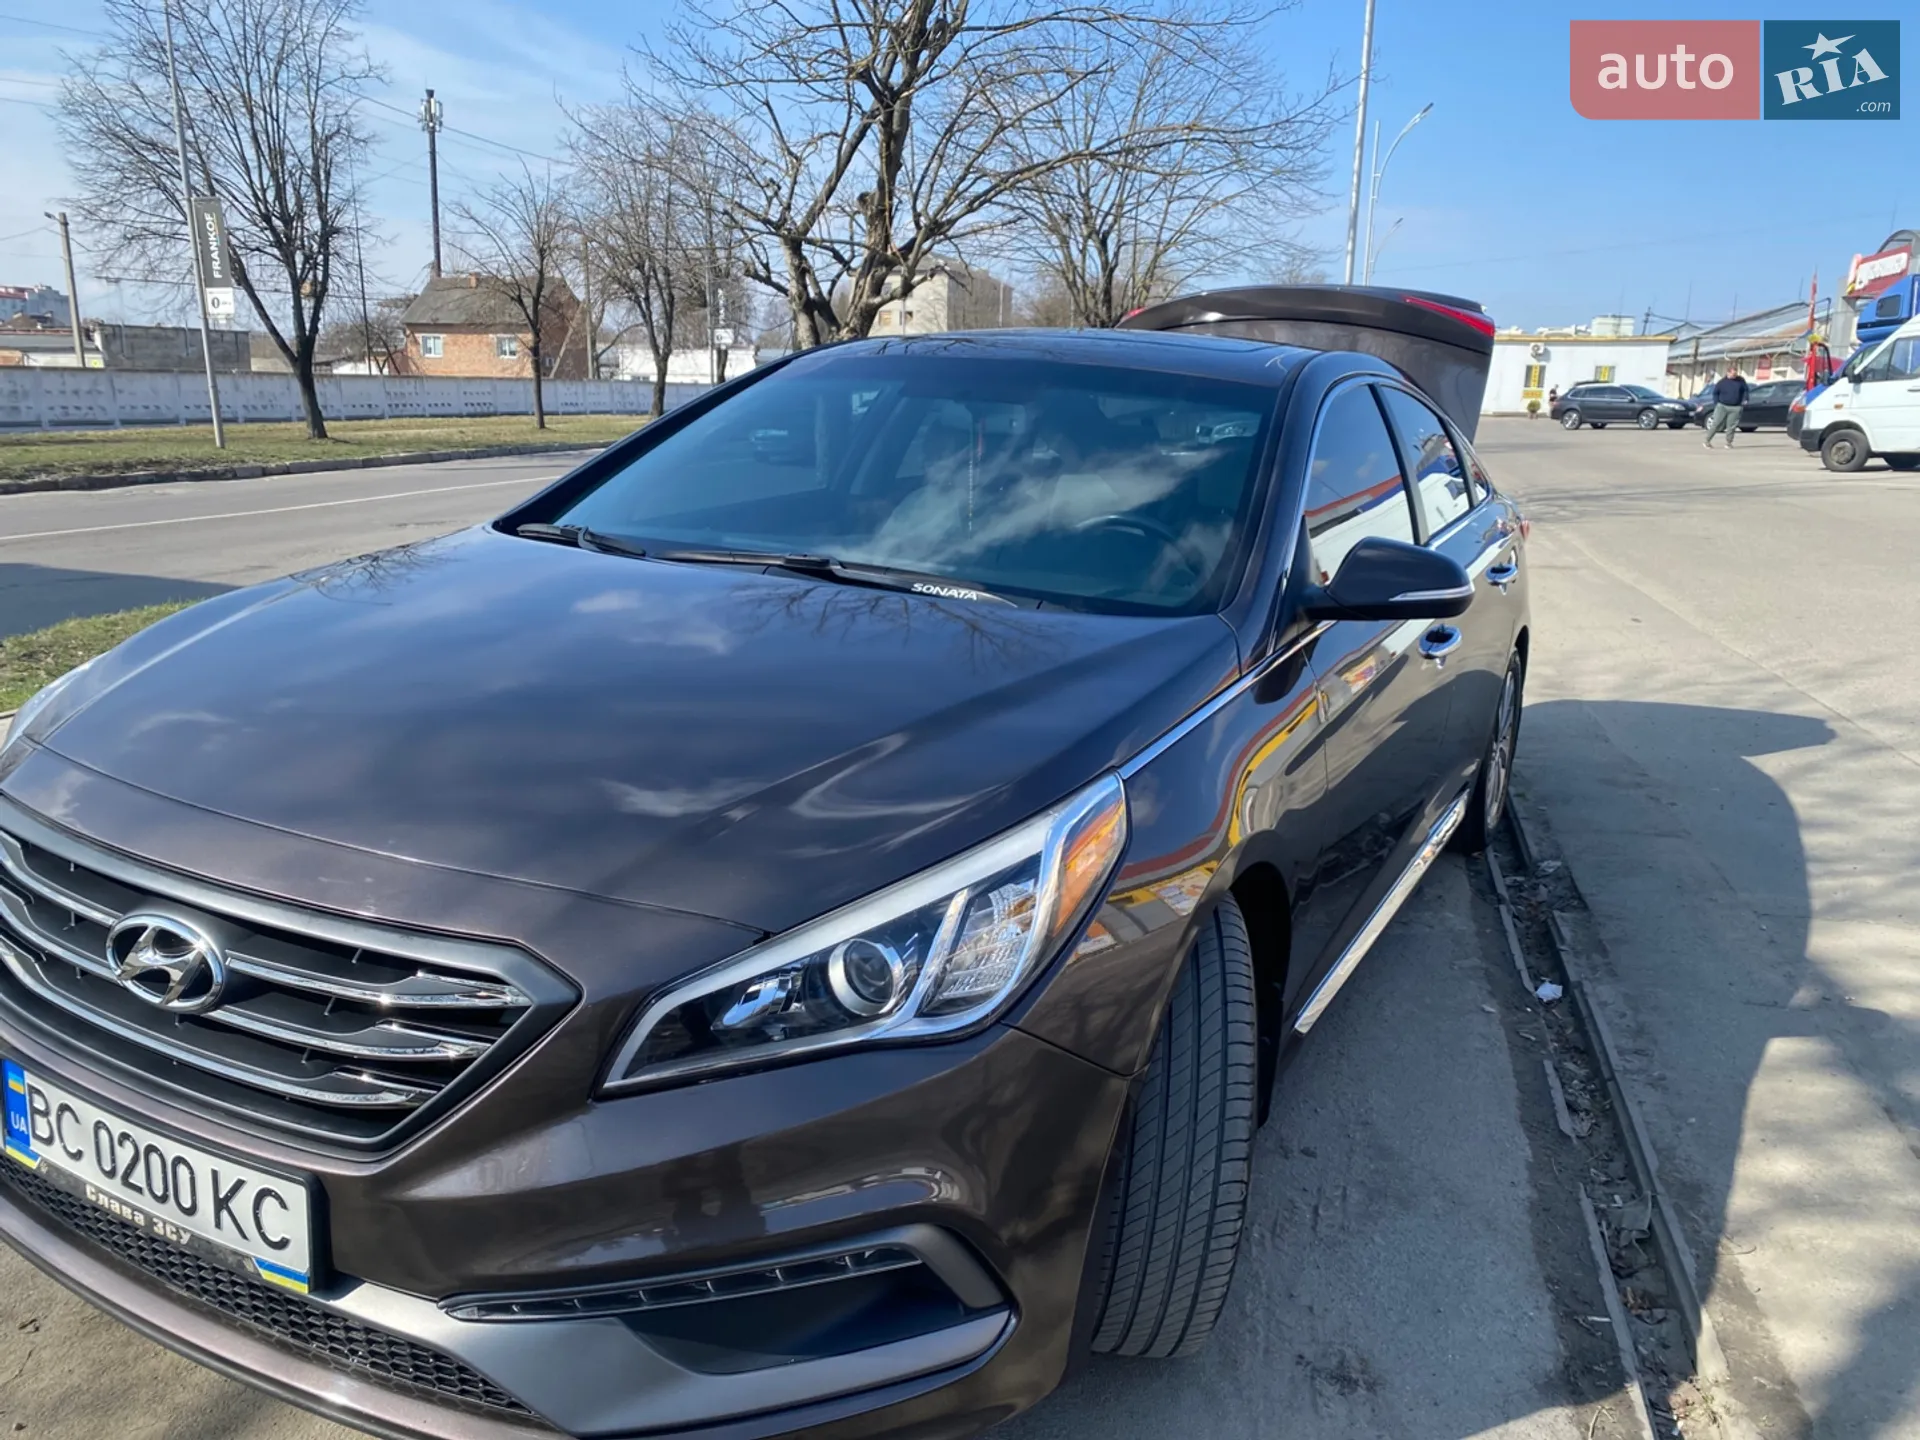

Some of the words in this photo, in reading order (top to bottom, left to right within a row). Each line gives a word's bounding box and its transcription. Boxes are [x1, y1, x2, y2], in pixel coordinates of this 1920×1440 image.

[204, 211, 222, 279] FRANKOF
[911, 582, 978, 601] SONATA
[10, 1111, 28, 1135] UA
[26, 1082, 84, 1162] BC
[93, 1119, 198, 1217] 0200
[211, 1167, 290, 1250] KC
[85, 1183, 145, 1226] Слава
[152, 1217, 192, 1245] ЗСУ
